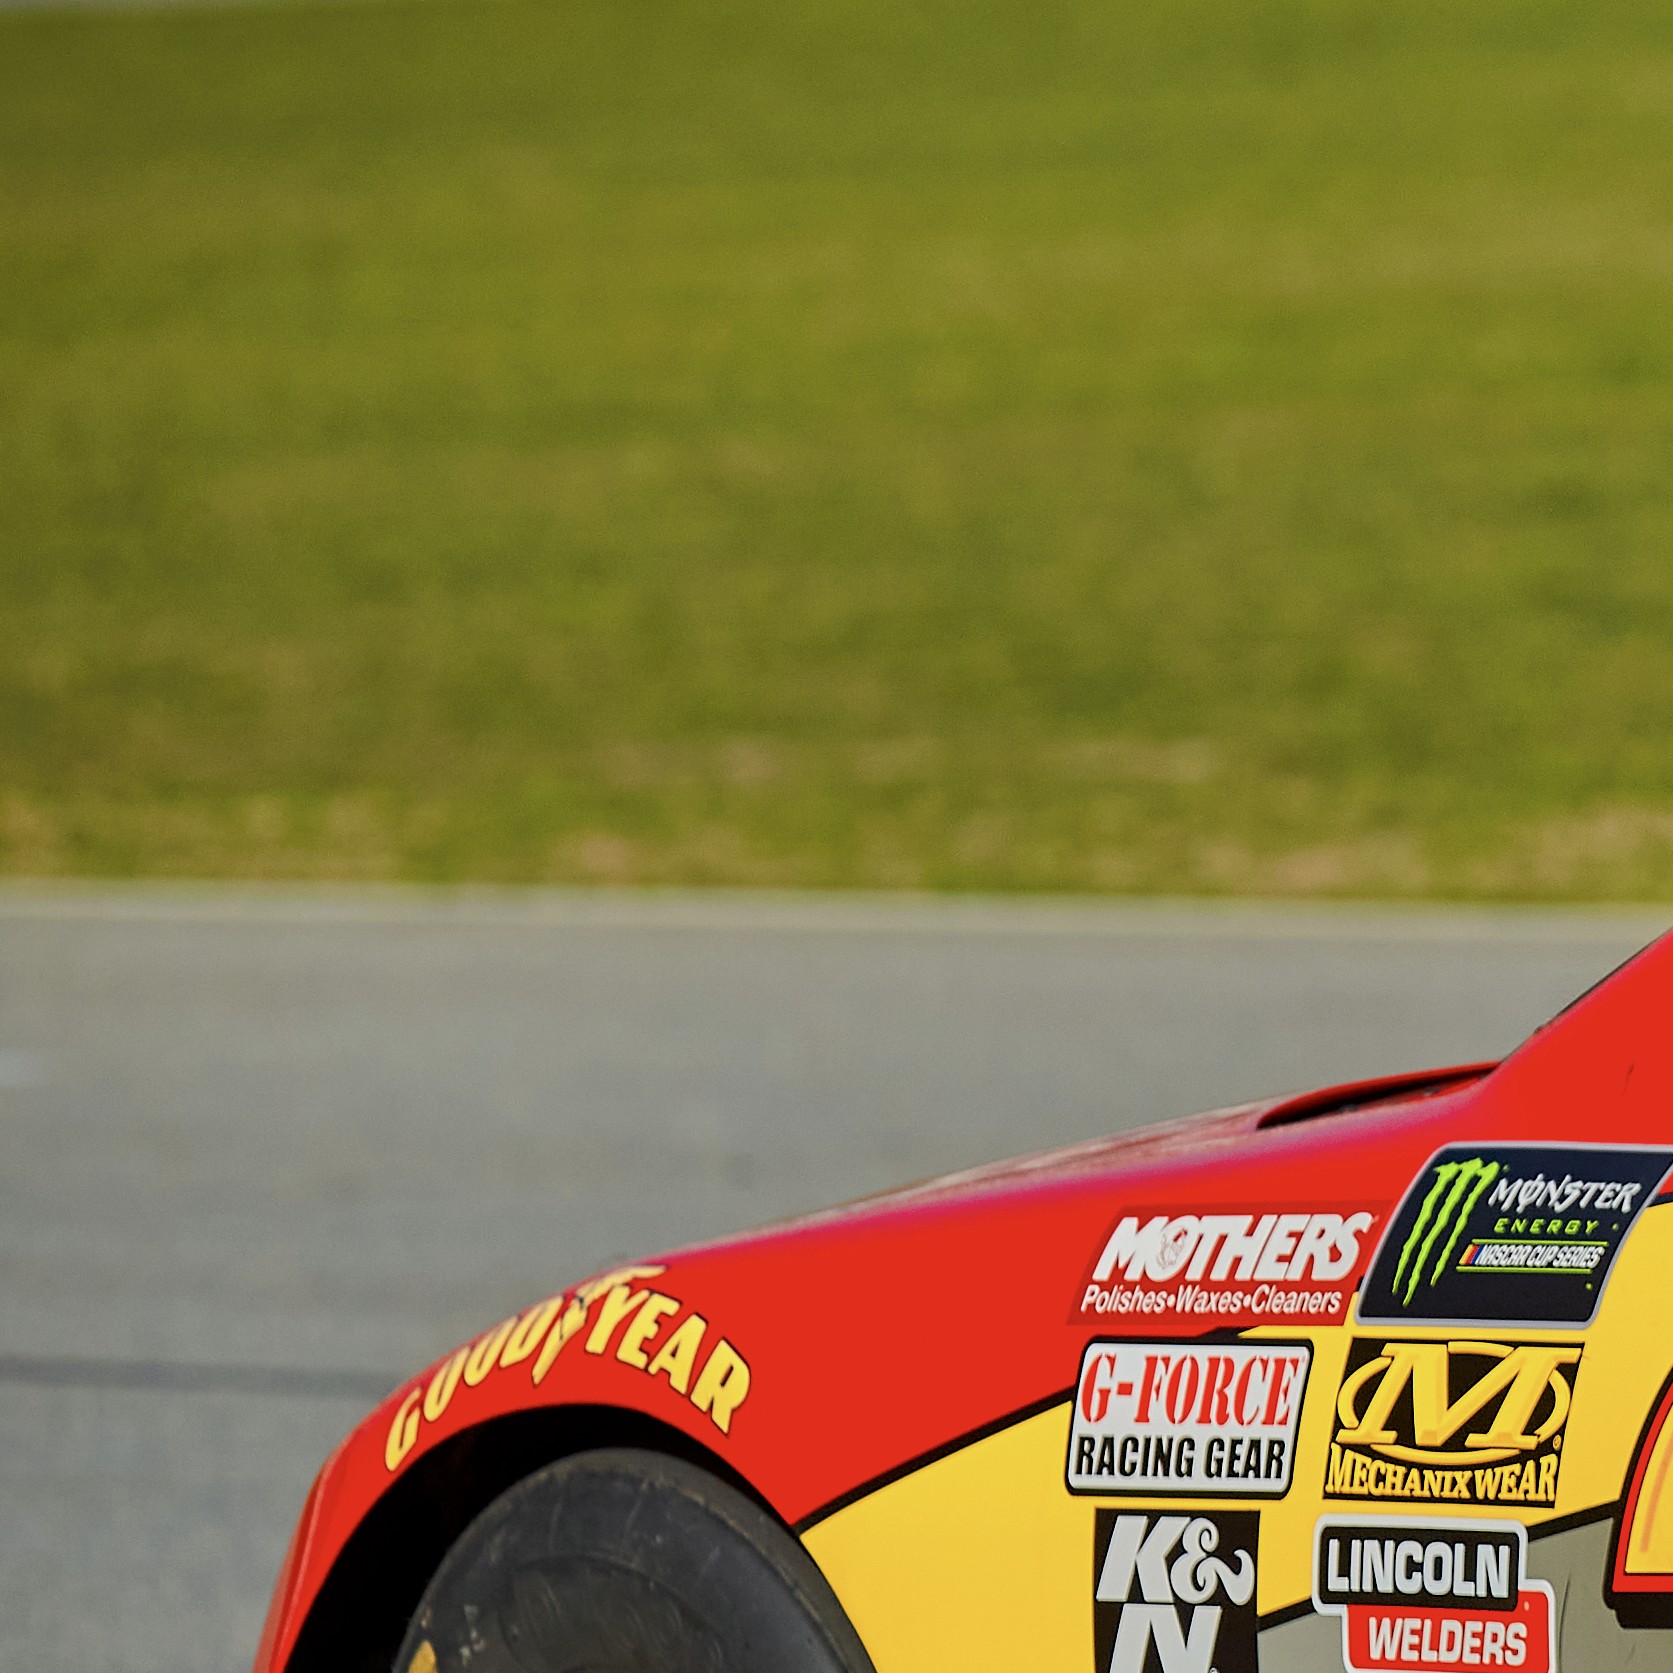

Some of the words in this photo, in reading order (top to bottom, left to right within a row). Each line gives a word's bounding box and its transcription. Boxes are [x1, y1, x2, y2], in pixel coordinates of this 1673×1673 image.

[1091, 1211, 1373, 1283] MOTHERS
[1492, 1216, 1600, 1236] ENERGY
[1476, 1243, 1530, 1267] NASCAR
[1526, 1244, 1555, 1268] CUP
[1552, 1245, 1606, 1269] SERIES
[1080, 1351, 1302, 1429] G-FORCE
[1075, 1432, 1202, 1478] RACING
[1205, 1434, 1287, 1481] GEAR
[1324, 1441, 1474, 1499] MECHANIX
[1473, 1453, 1560, 1502] WEAR
[1326, 1537, 1511, 1599] LINCOLN
[1367, 1615, 1528, 1667] WELDERS
